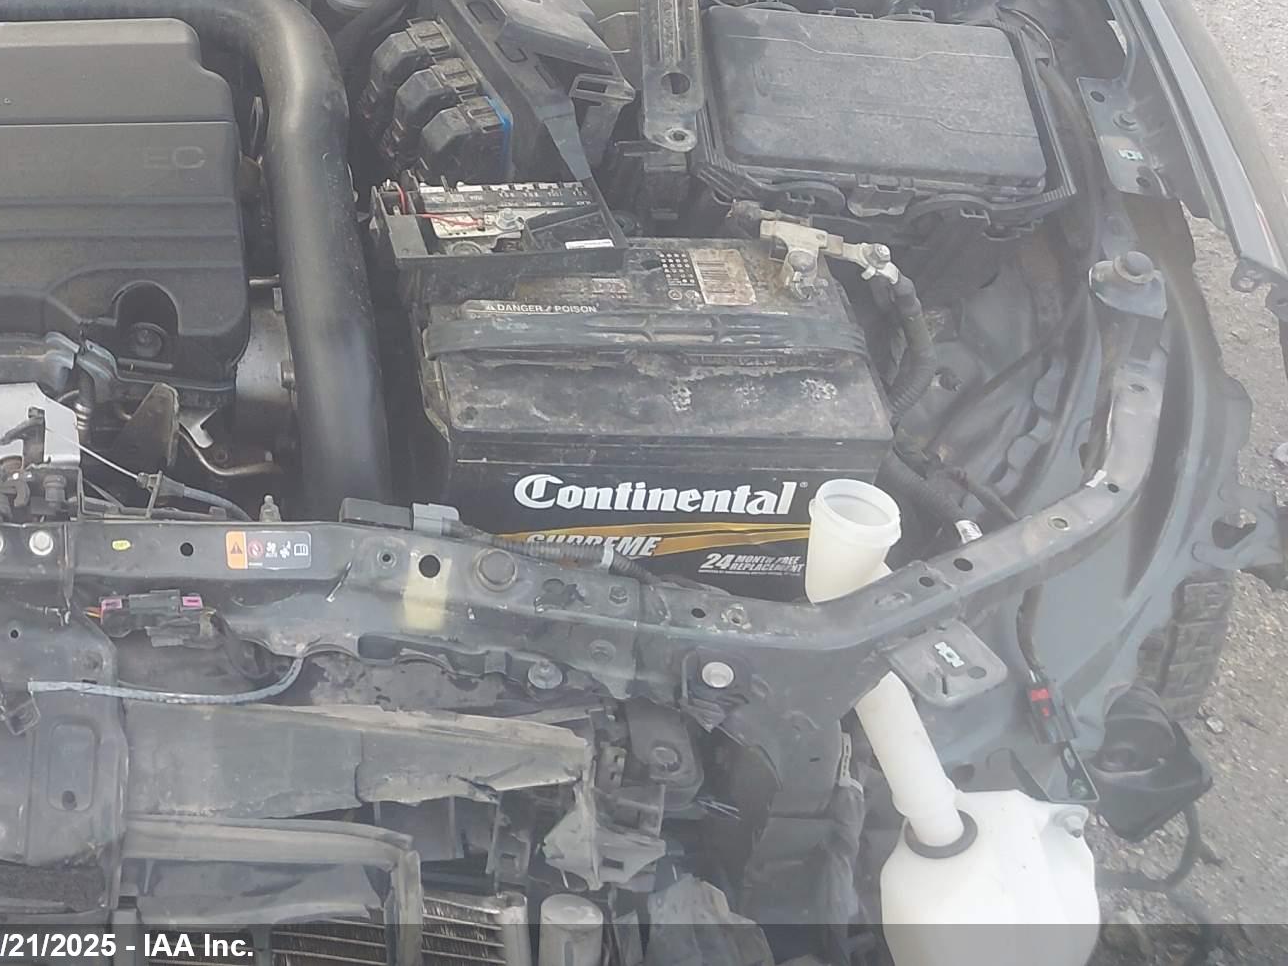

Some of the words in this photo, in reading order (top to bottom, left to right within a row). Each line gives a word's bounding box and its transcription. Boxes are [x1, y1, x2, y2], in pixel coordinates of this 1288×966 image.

[496, 303, 543, 313] DANGER
[554, 304, 598, 314] POISON
[513, 473, 798, 516] Continental
[699, 552, 735, 570] 24
